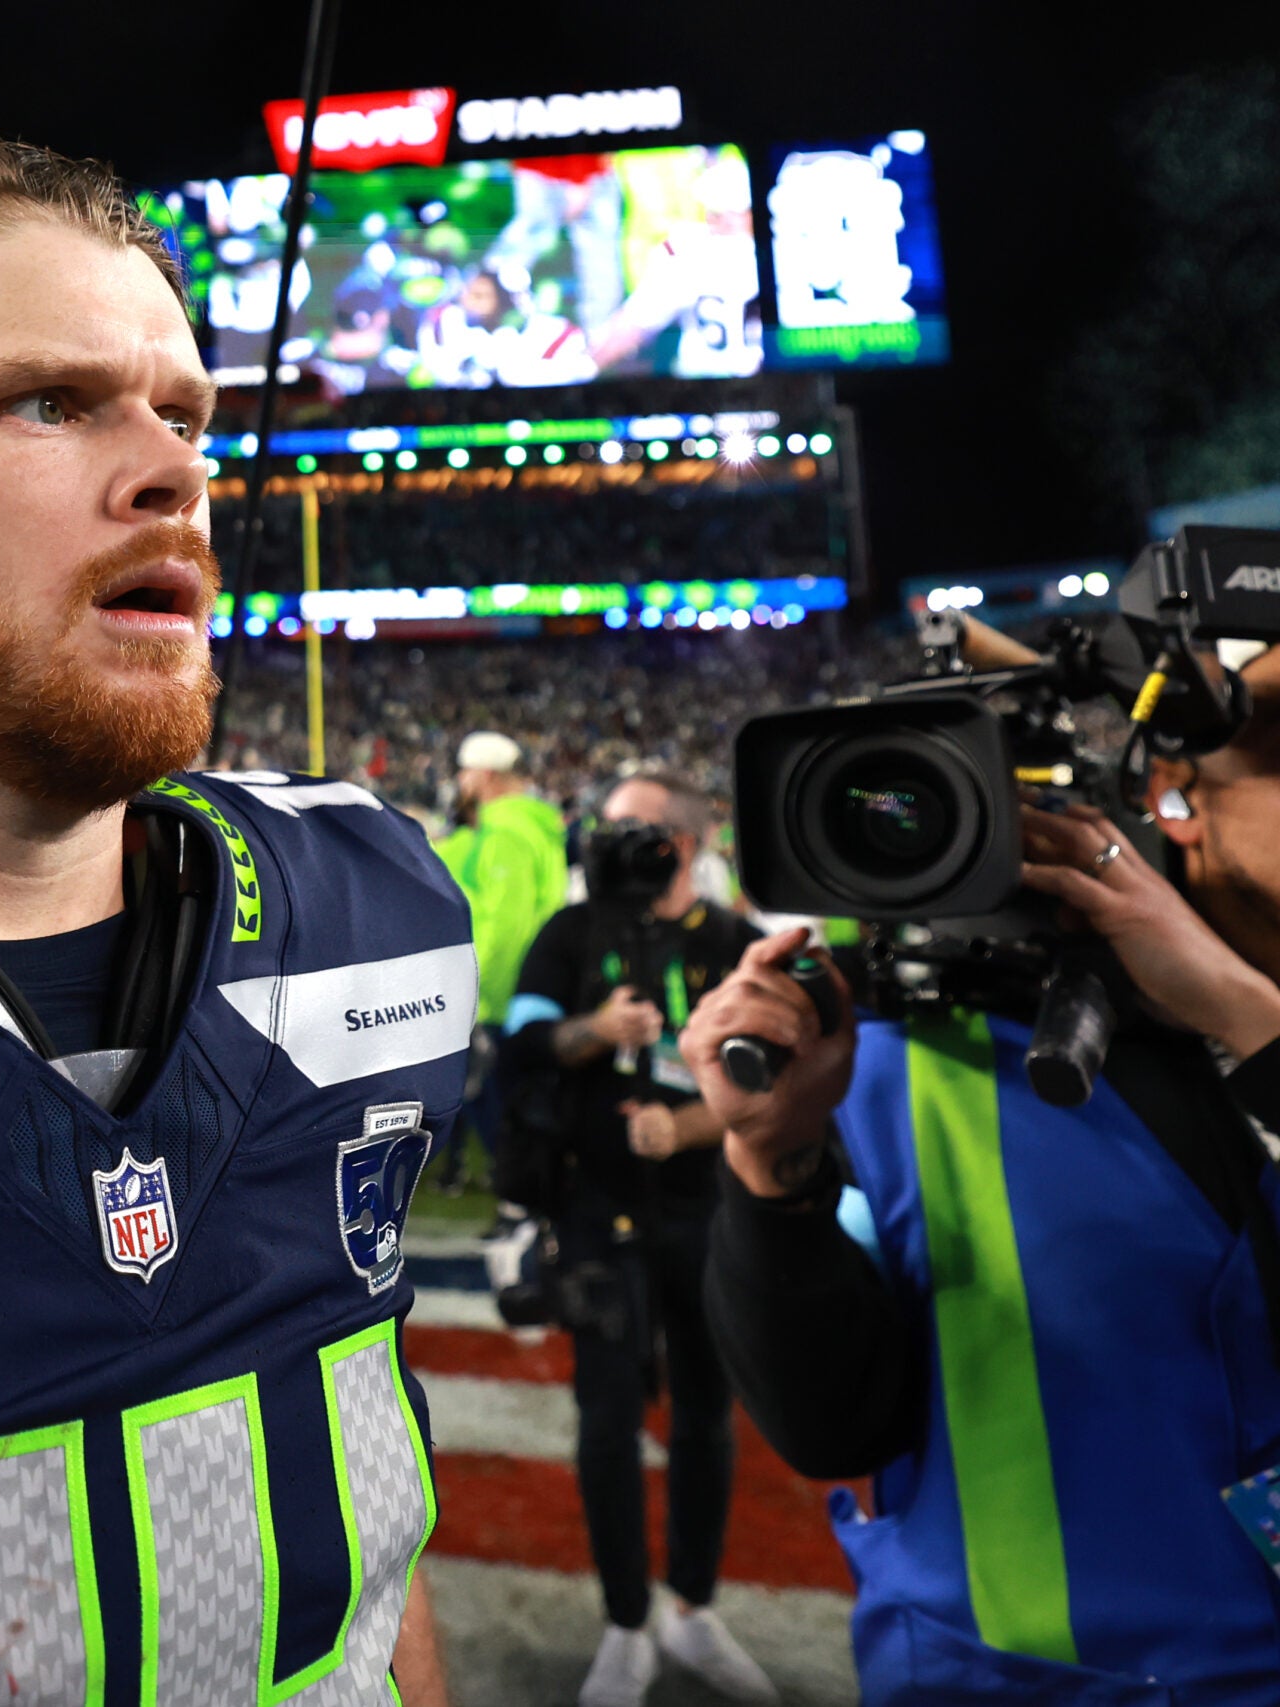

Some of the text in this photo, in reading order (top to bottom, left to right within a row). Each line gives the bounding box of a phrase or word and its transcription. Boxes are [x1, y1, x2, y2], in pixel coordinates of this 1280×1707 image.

[344, 994, 446, 1032] SEAHAWKS
[375, 1116, 408, 1129] EST 1976
[112, 1208, 169, 1260] NFL
